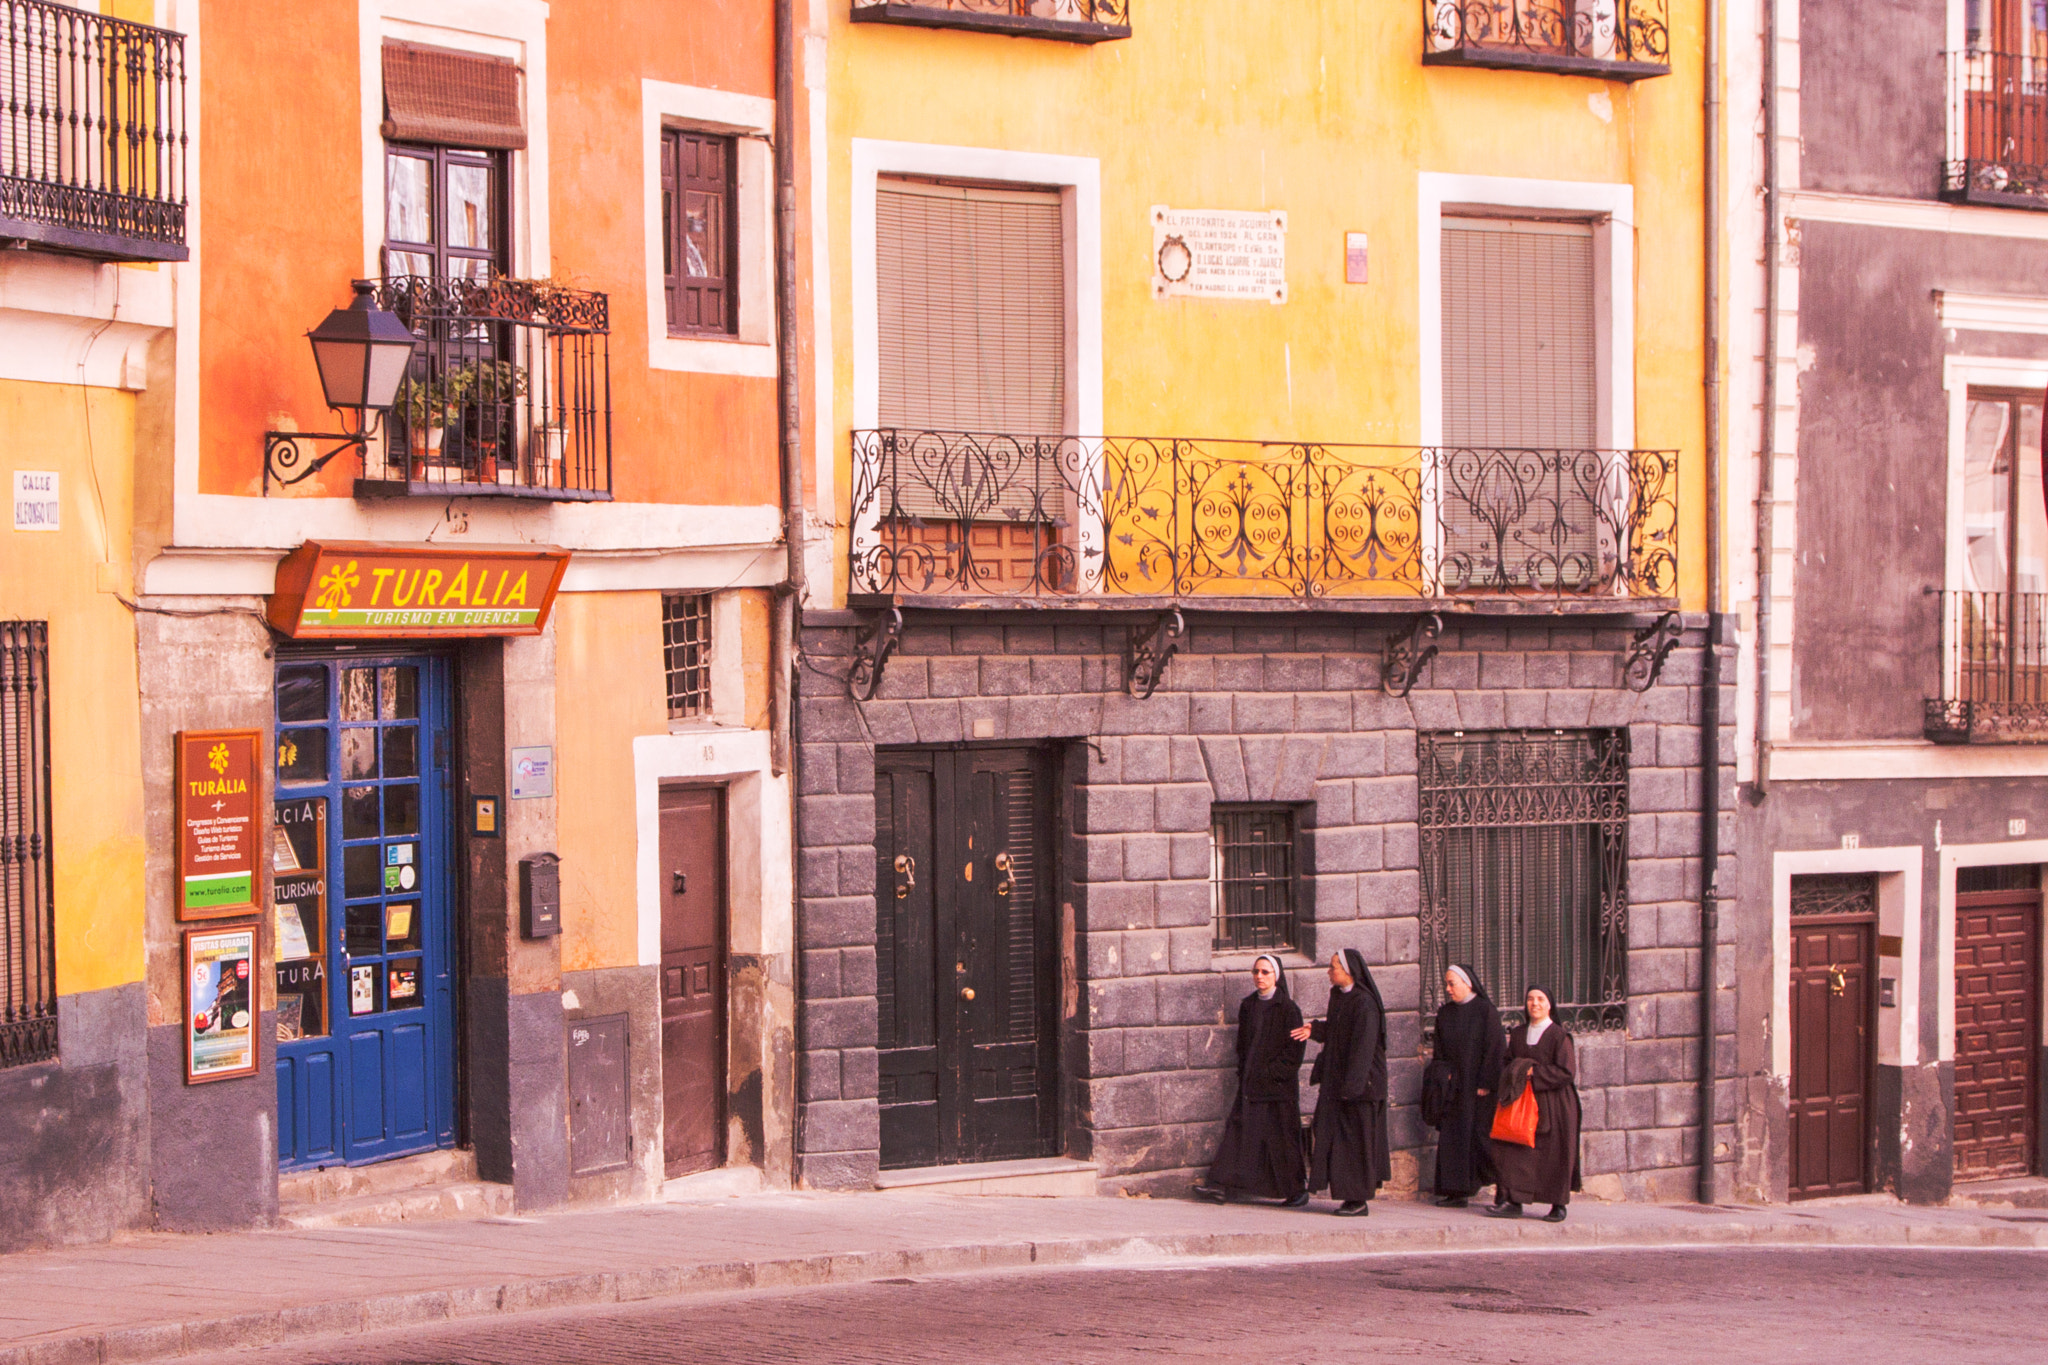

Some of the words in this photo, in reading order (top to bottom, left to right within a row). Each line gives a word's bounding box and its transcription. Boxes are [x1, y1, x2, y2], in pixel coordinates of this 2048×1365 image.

[1166, 216, 1177, 226] EL
[1181, 216, 1225, 228] PATRONATO
[1240, 219, 1272, 229] AGUIRRE
[1188, 230, 1201, 238] DEL
[1244, 231, 1253, 240] AL
[1257, 232, 1277, 241] GRAN
[1195, 241, 1236, 252] FILANTROPO
[1204, 255, 1223, 265] LUCAS
[1226, 255, 1250, 267] AGUIRRE
[1252, 269, 1266, 277] CASA
[22, 474, 51, 491] CALLE
[16, 502, 46, 524] ALFONSO
[46, 502, 58, 524] VIII
[369, 561, 528, 607] TURALIA
[365, 612, 432, 624] TURISMO
[438, 612, 456, 624] EN
[463, 611, 521, 624] CUENCA
[703, 745, 714, 761] 43
[189, 777, 247, 797] TURALIA
[187, 819, 213, 828] Congresos
[216, 816, 249, 825] Convenciones
[2011, 820, 2025, 834] 49
[193, 827, 210, 836] Diseño
[210, 826, 222, 834] Web
[211, 835, 219, 843] de
[218, 834, 239, 843] Turismo
[1845, 836, 1857, 849] 47
[200, 844, 221, 853] Turismo
[220, 843, 236, 851] Activo
[213, 853, 220, 861] de
[219, 852, 242, 861] Servicios
[189, 885, 247, 897] www.turalia.com
[274, 880, 324, 900] TURISMO
[193, 940, 219, 952] VISITAS
[220, 937, 249, 949] GUIADAS
[277, 959, 326, 985] TURA
